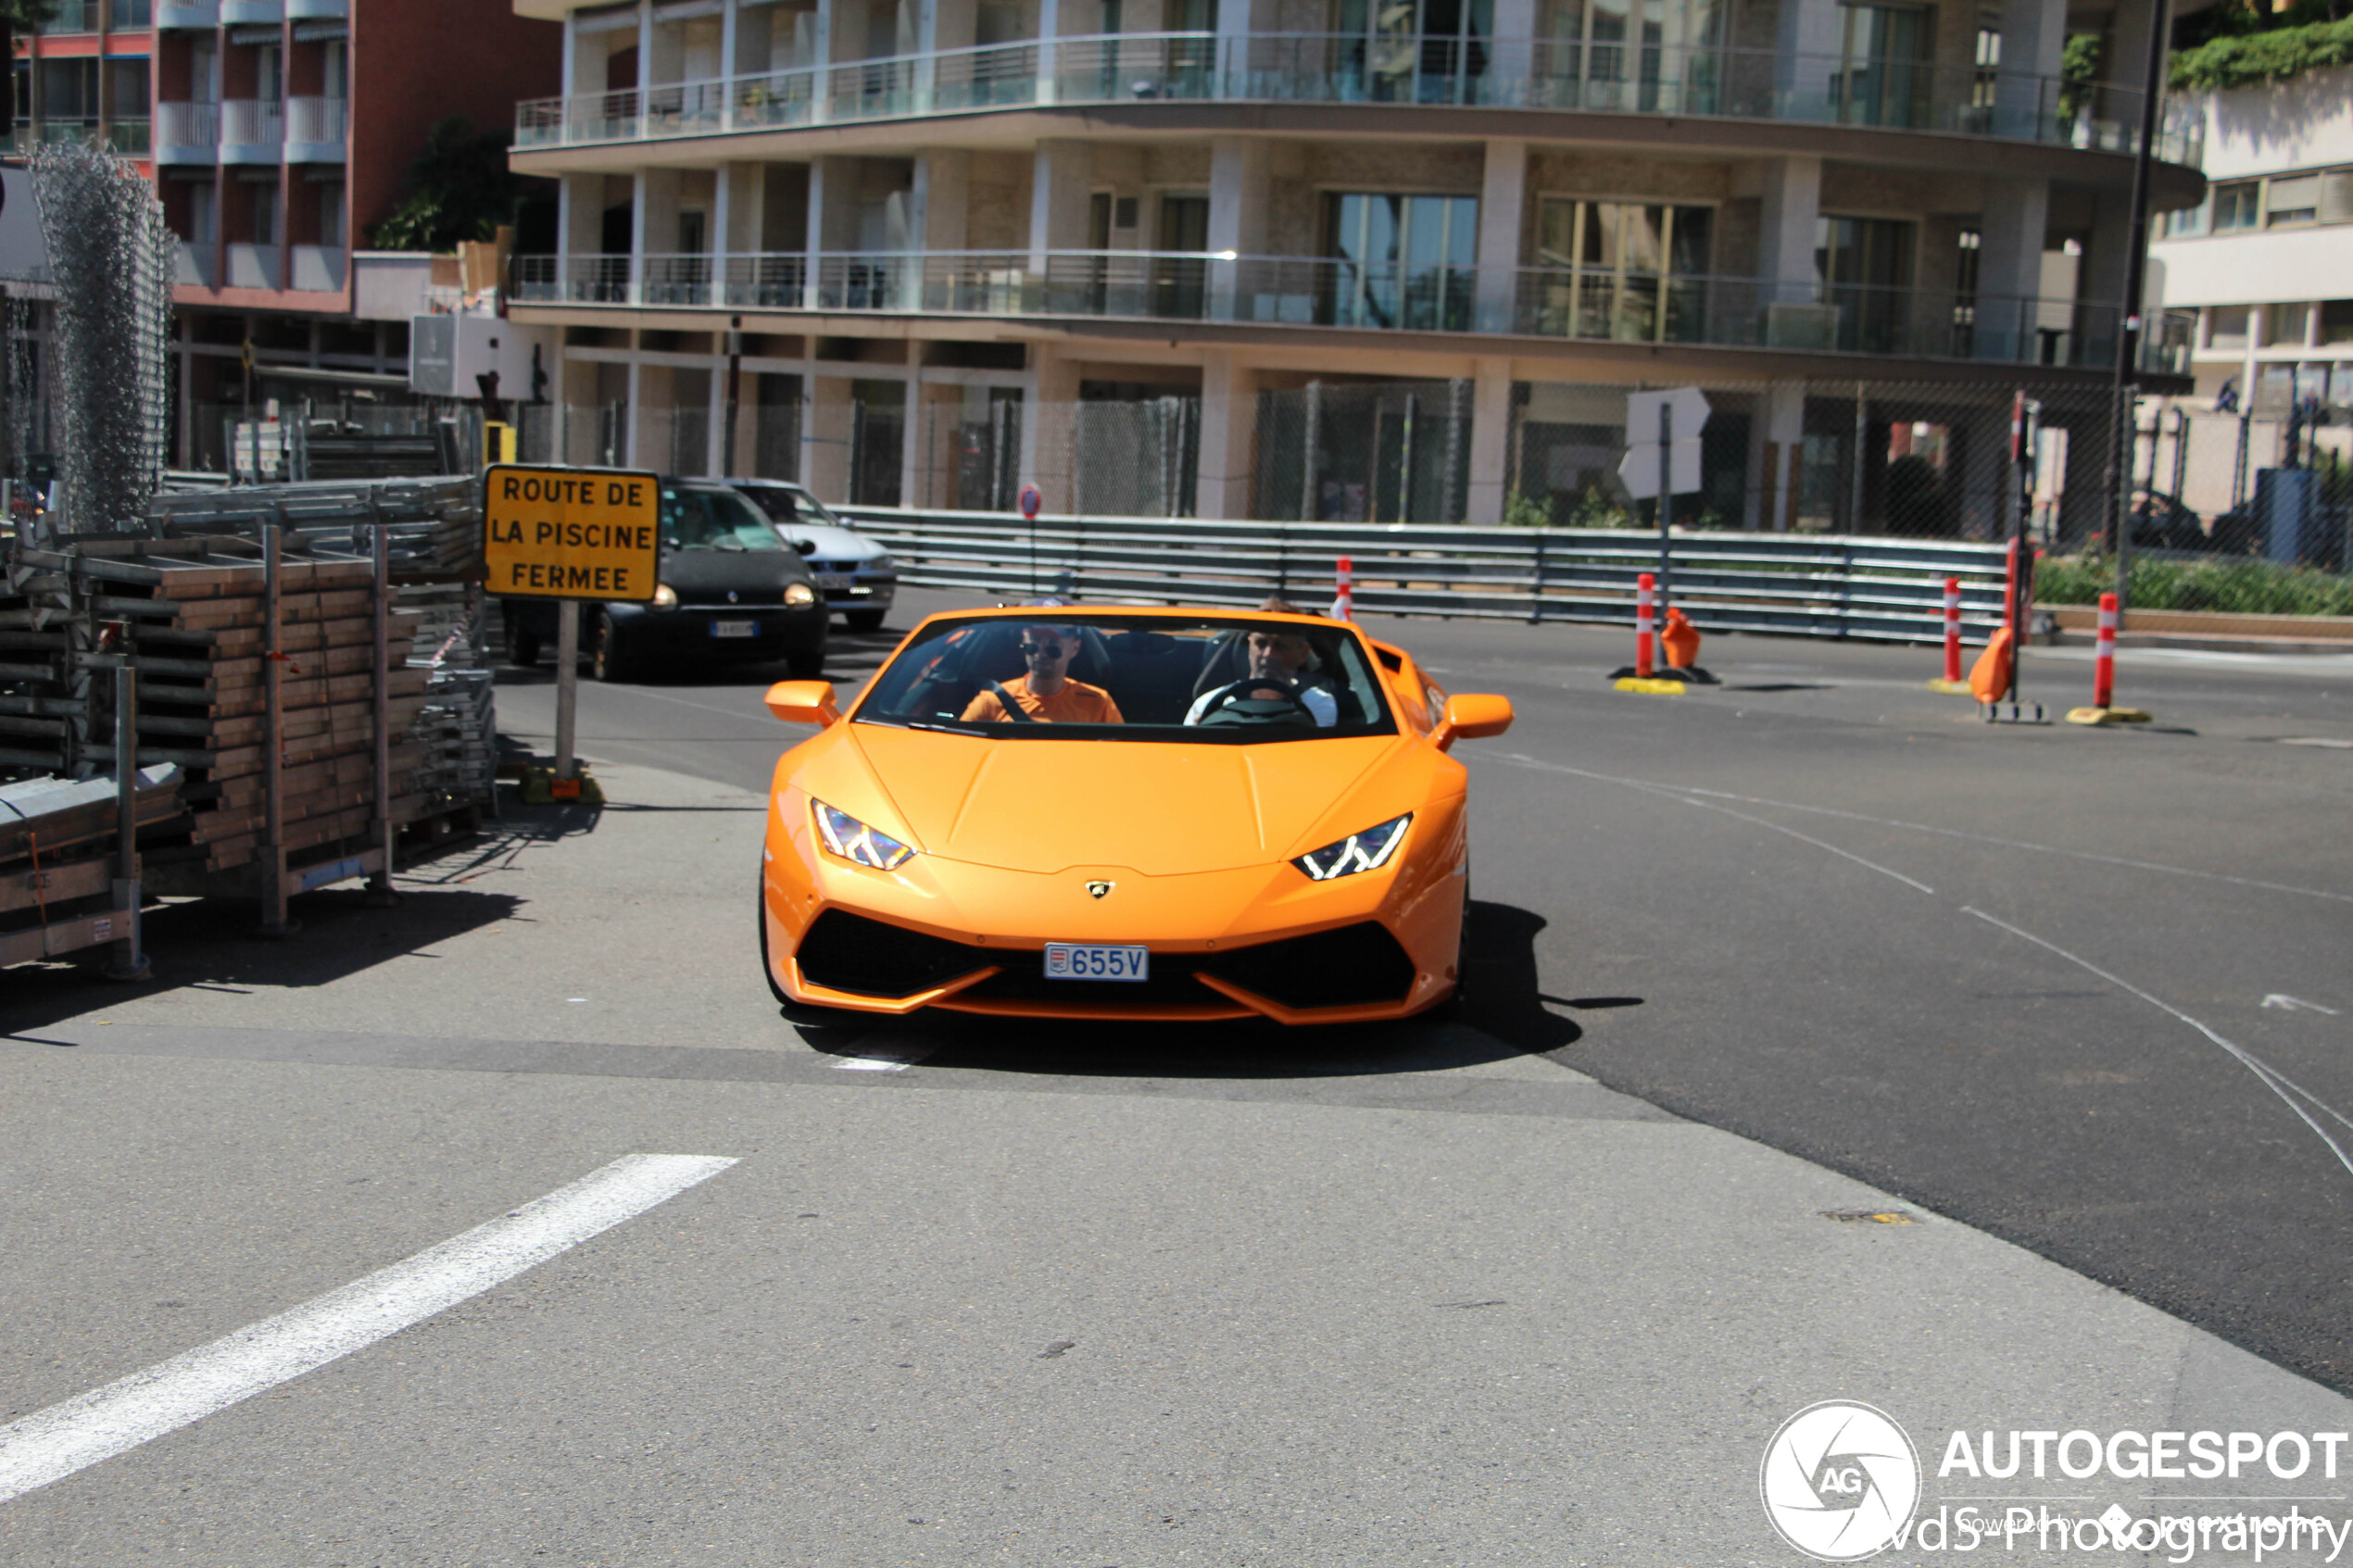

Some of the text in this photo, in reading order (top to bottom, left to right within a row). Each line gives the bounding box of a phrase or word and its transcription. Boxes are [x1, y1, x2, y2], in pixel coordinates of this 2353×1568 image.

[504, 477, 643, 507] ROUTE DE
[492, 520, 652, 549] LA PISCINE
[512, 563, 628, 591] FERMEE
[1072, 949, 1142, 976] 655V
